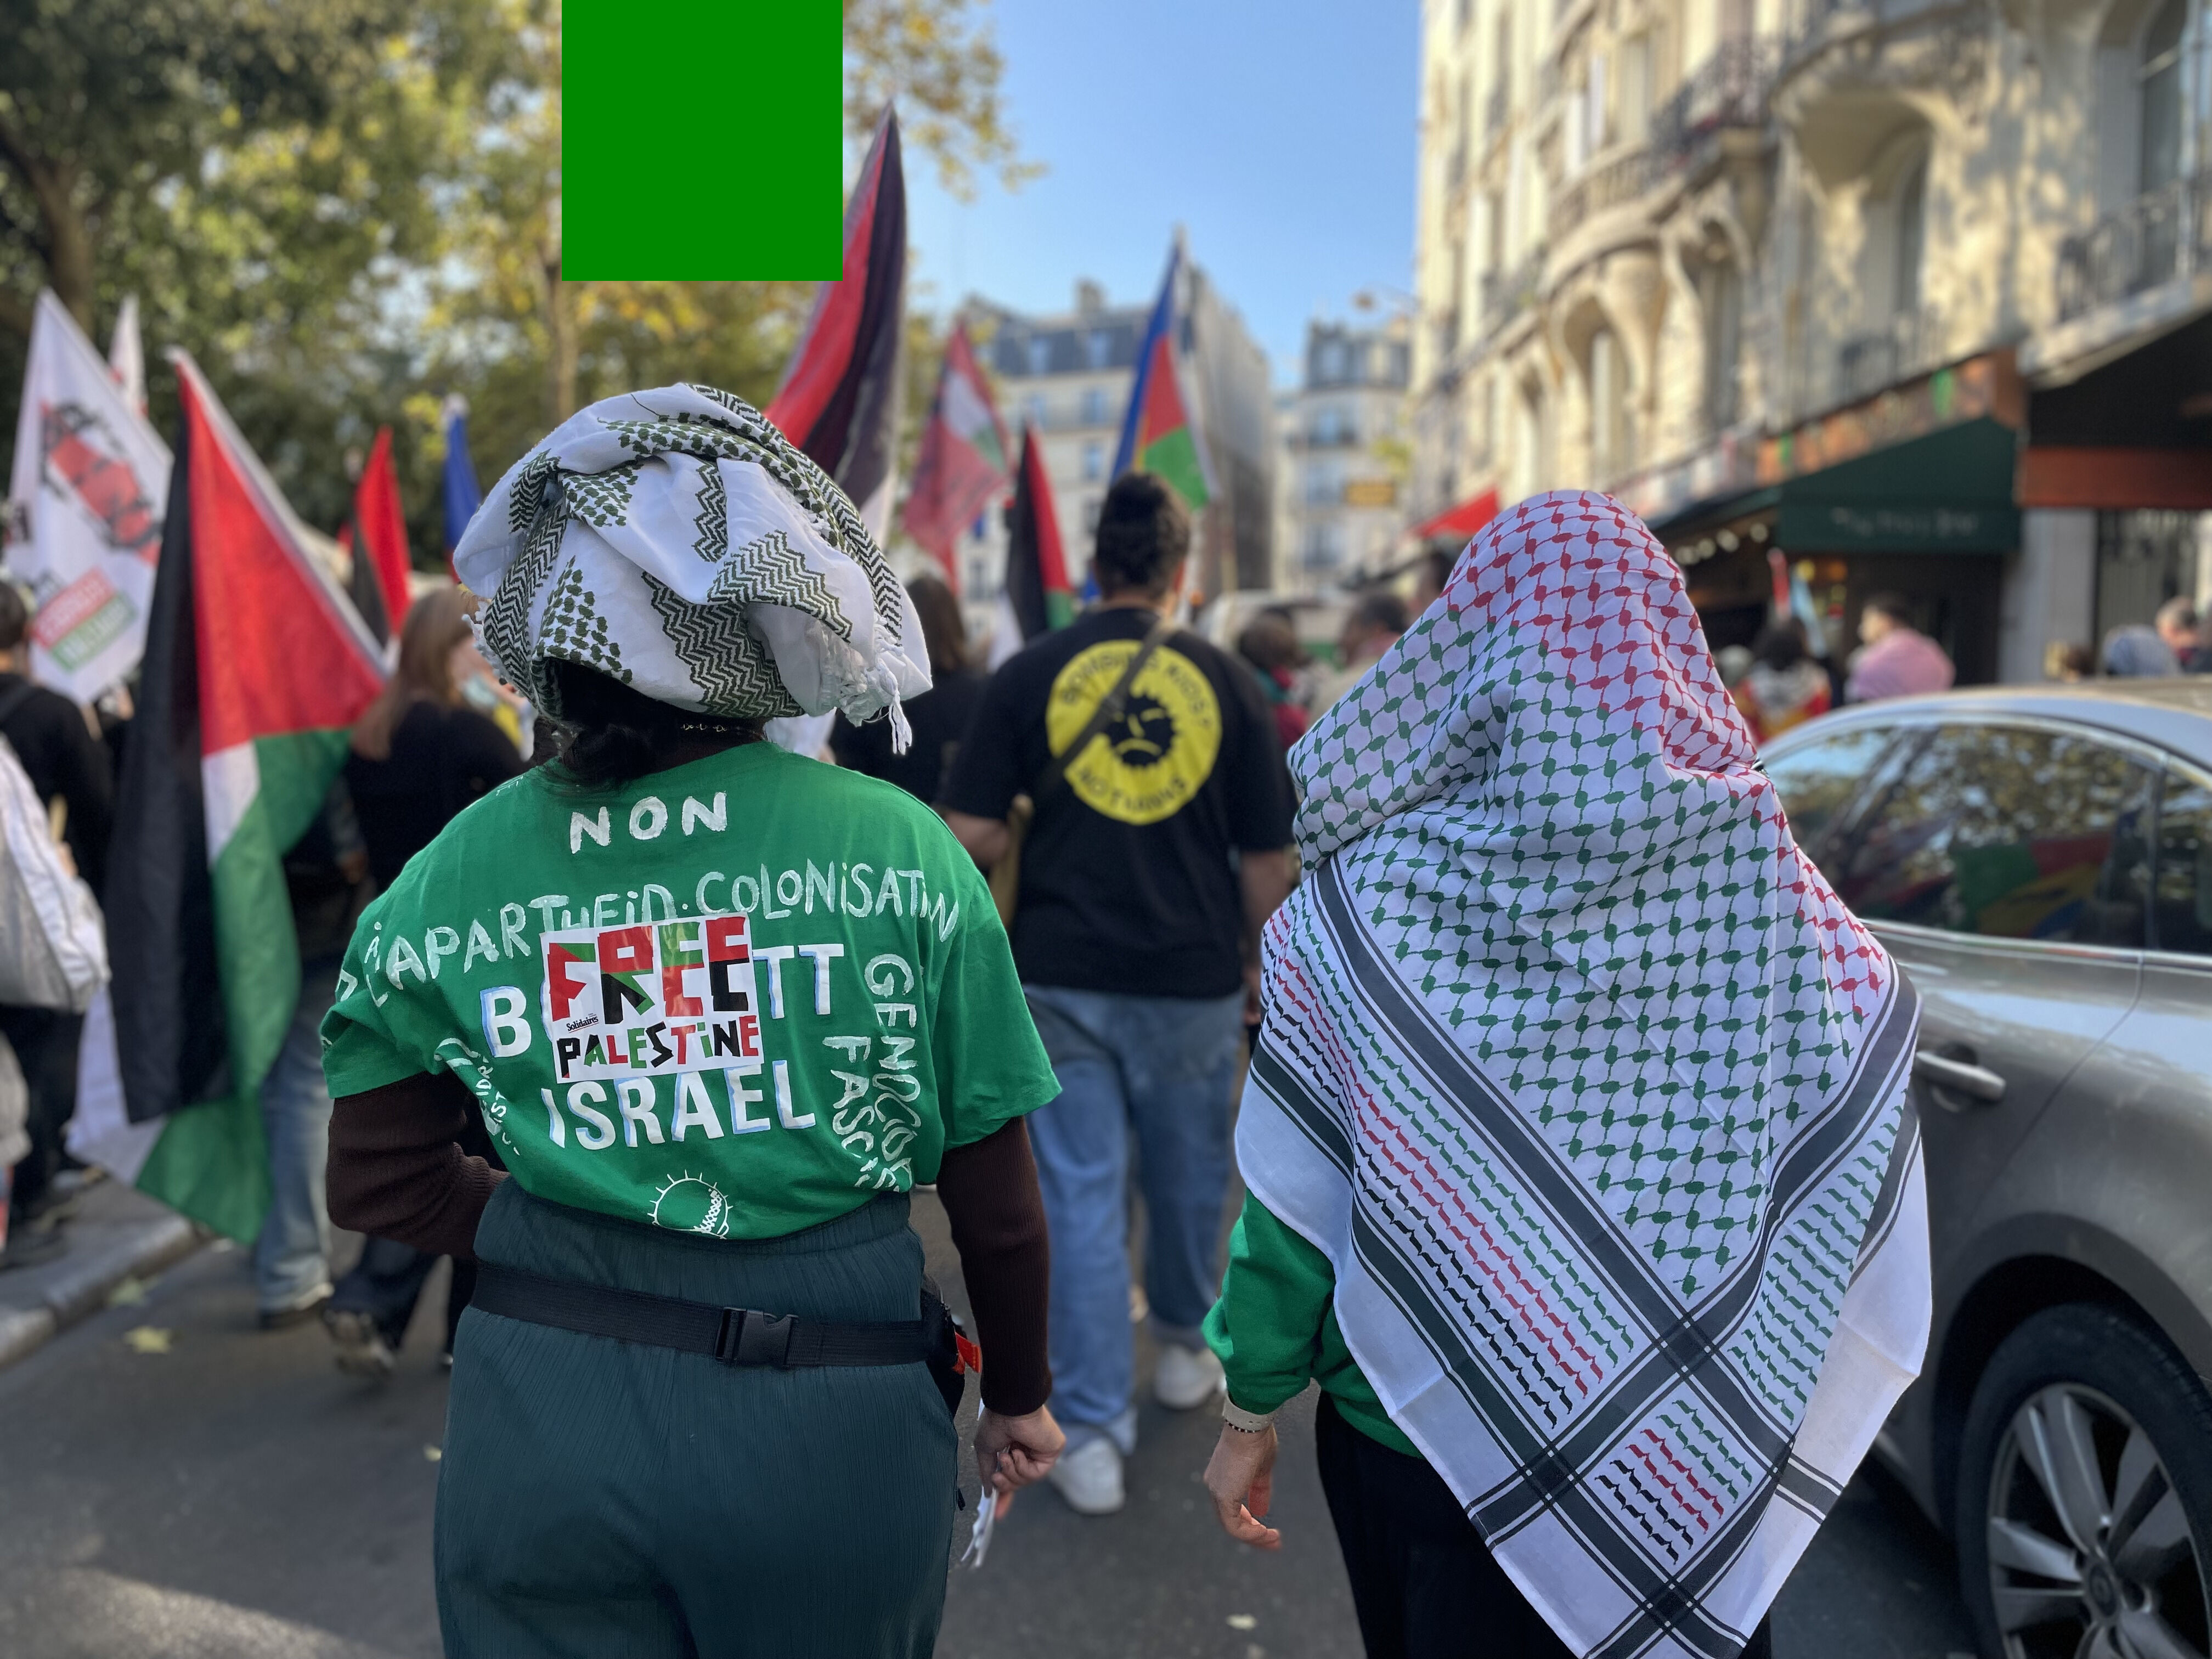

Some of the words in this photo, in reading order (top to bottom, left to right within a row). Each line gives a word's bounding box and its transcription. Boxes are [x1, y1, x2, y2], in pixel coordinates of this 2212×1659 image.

[570, 791, 727, 854] NON
[548, 917, 750, 1025] FREE
[566, 1016, 599, 1032] Solidaires
[541, 1060, 816, 1150] ISRAEL
